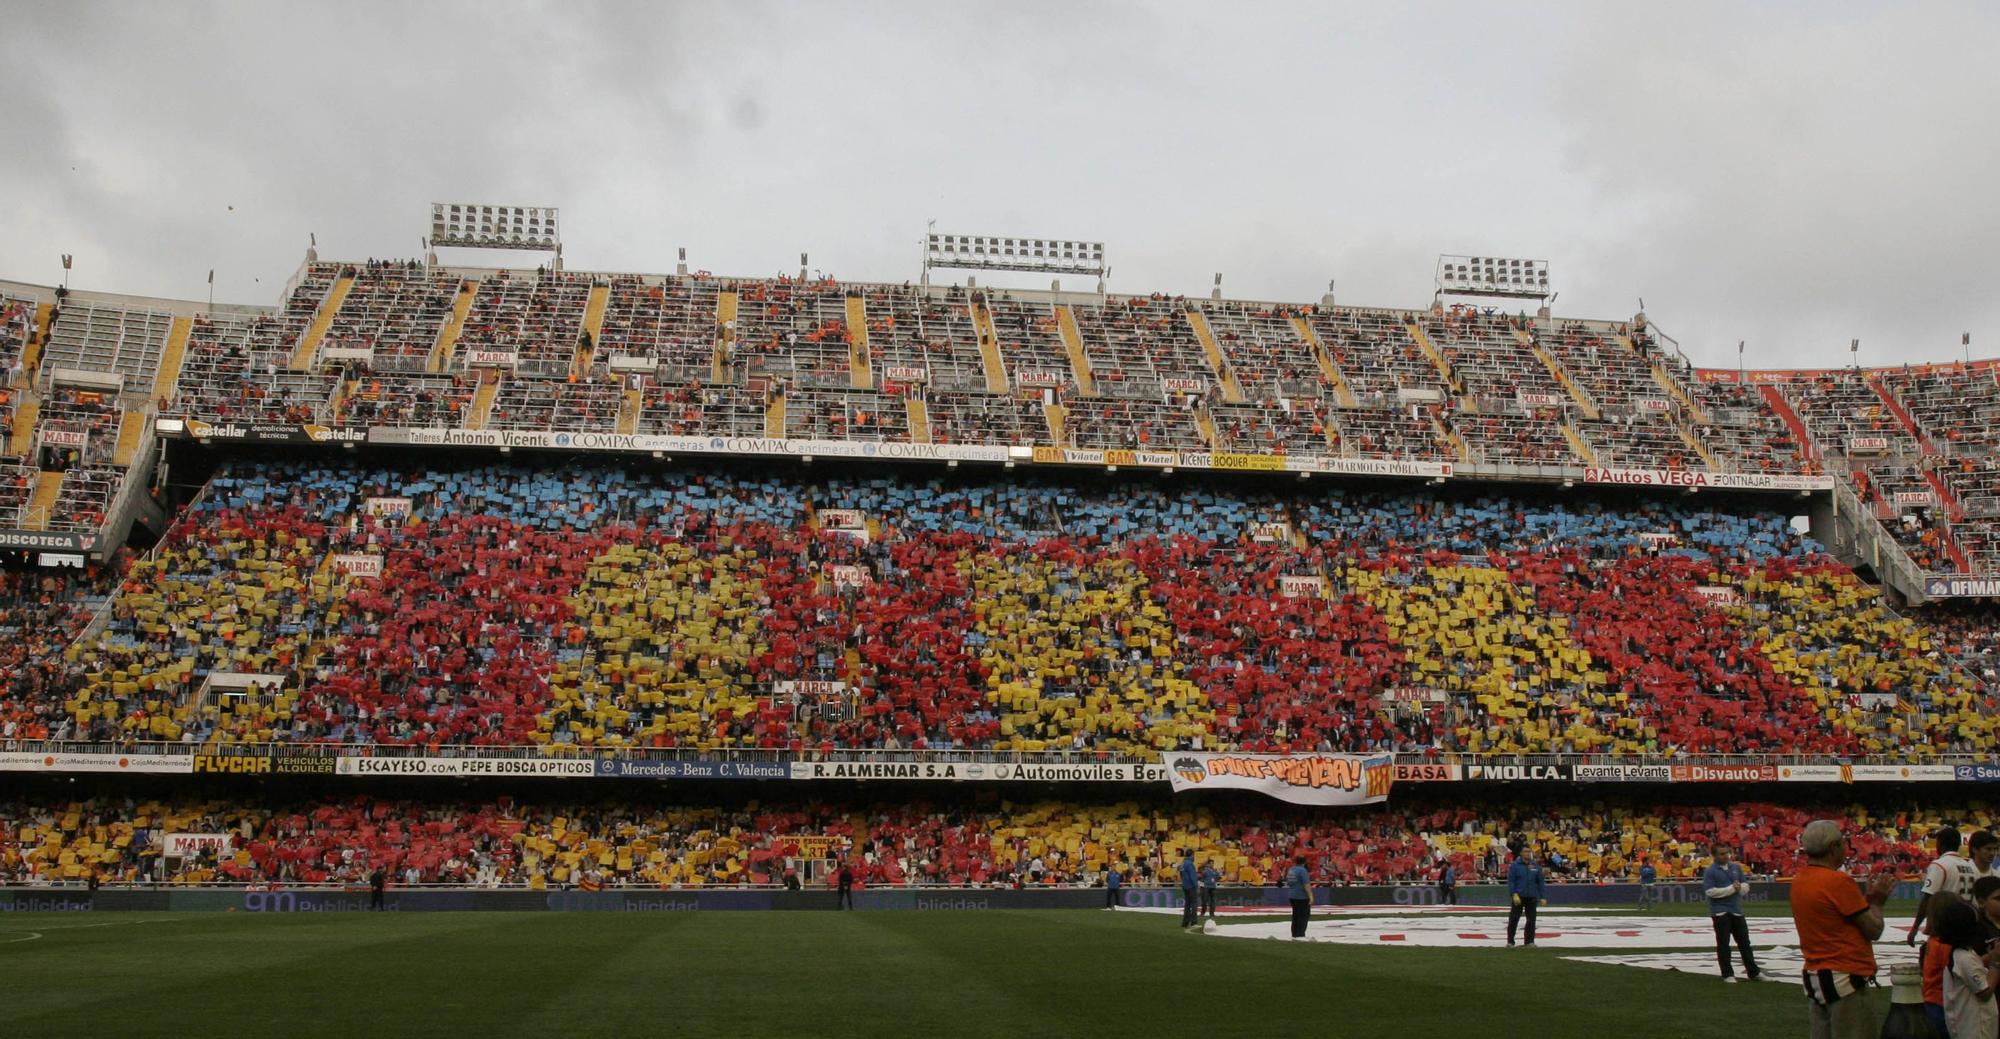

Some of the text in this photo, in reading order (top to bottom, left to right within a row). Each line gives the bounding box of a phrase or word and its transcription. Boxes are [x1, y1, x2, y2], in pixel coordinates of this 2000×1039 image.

[476, 351, 510, 362] MARCA
[890, 368, 921, 378] MARCA
[1022, 372, 1054, 382] MARCA
[1167, 379, 1199, 389] MARCA
[1522, 394, 1551, 404] MARCA
[195, 425, 247, 437] castellar
[251, 424, 298, 433] demoliciones
[314, 427, 366, 441] castellar
[43, 431, 84, 444] MARCA
[410, 432, 441, 444] Talleres
[443, 431, 495, 445] Antonio
[502, 432, 549, 447] Vicente
[572, 434, 704, 451] COMPAC encimeras
[1853, 438, 1885, 448] MARCA
[726, 439, 856, 456] COMPAC encimeras
[877, 442, 1005, 460] COMPAC encimeras
[1035, 449, 1103, 462] GAM Vilatel
[1107, 452, 1173, 465] GAM Vilatel
[1179, 453, 1211, 467] VICENTE
[1336, 461, 1419, 474] MARMOLES POBLA
[1600, 468, 1707, 485] Autos VEGA
[0, 534, 73, 547] DISCOTECA
[1394, 688, 1431, 700] MARCA
[195, 756, 271, 773] FLYCAR
[276, 765, 333, 774] ALQUILER
[462, 761, 492, 773] PEPE
[497, 761, 537, 773] BOSCA
[540, 761, 592, 774] OPTICOS
[720, 763, 733, 776] C.
[736, 763, 785, 777] Valencia
[813, 764, 956, 778] R. ALMENAR S.A
[1012, 763, 1124, 780] Automóviles
[1483, 765, 1567, 780] MOLCA.
[1576, 766, 1621, 777] Levante
[1623, 766, 1669, 777] Levante
[1692, 767, 1759, 780] Disvauto
[0, 899, 95, 912] ublicidad
